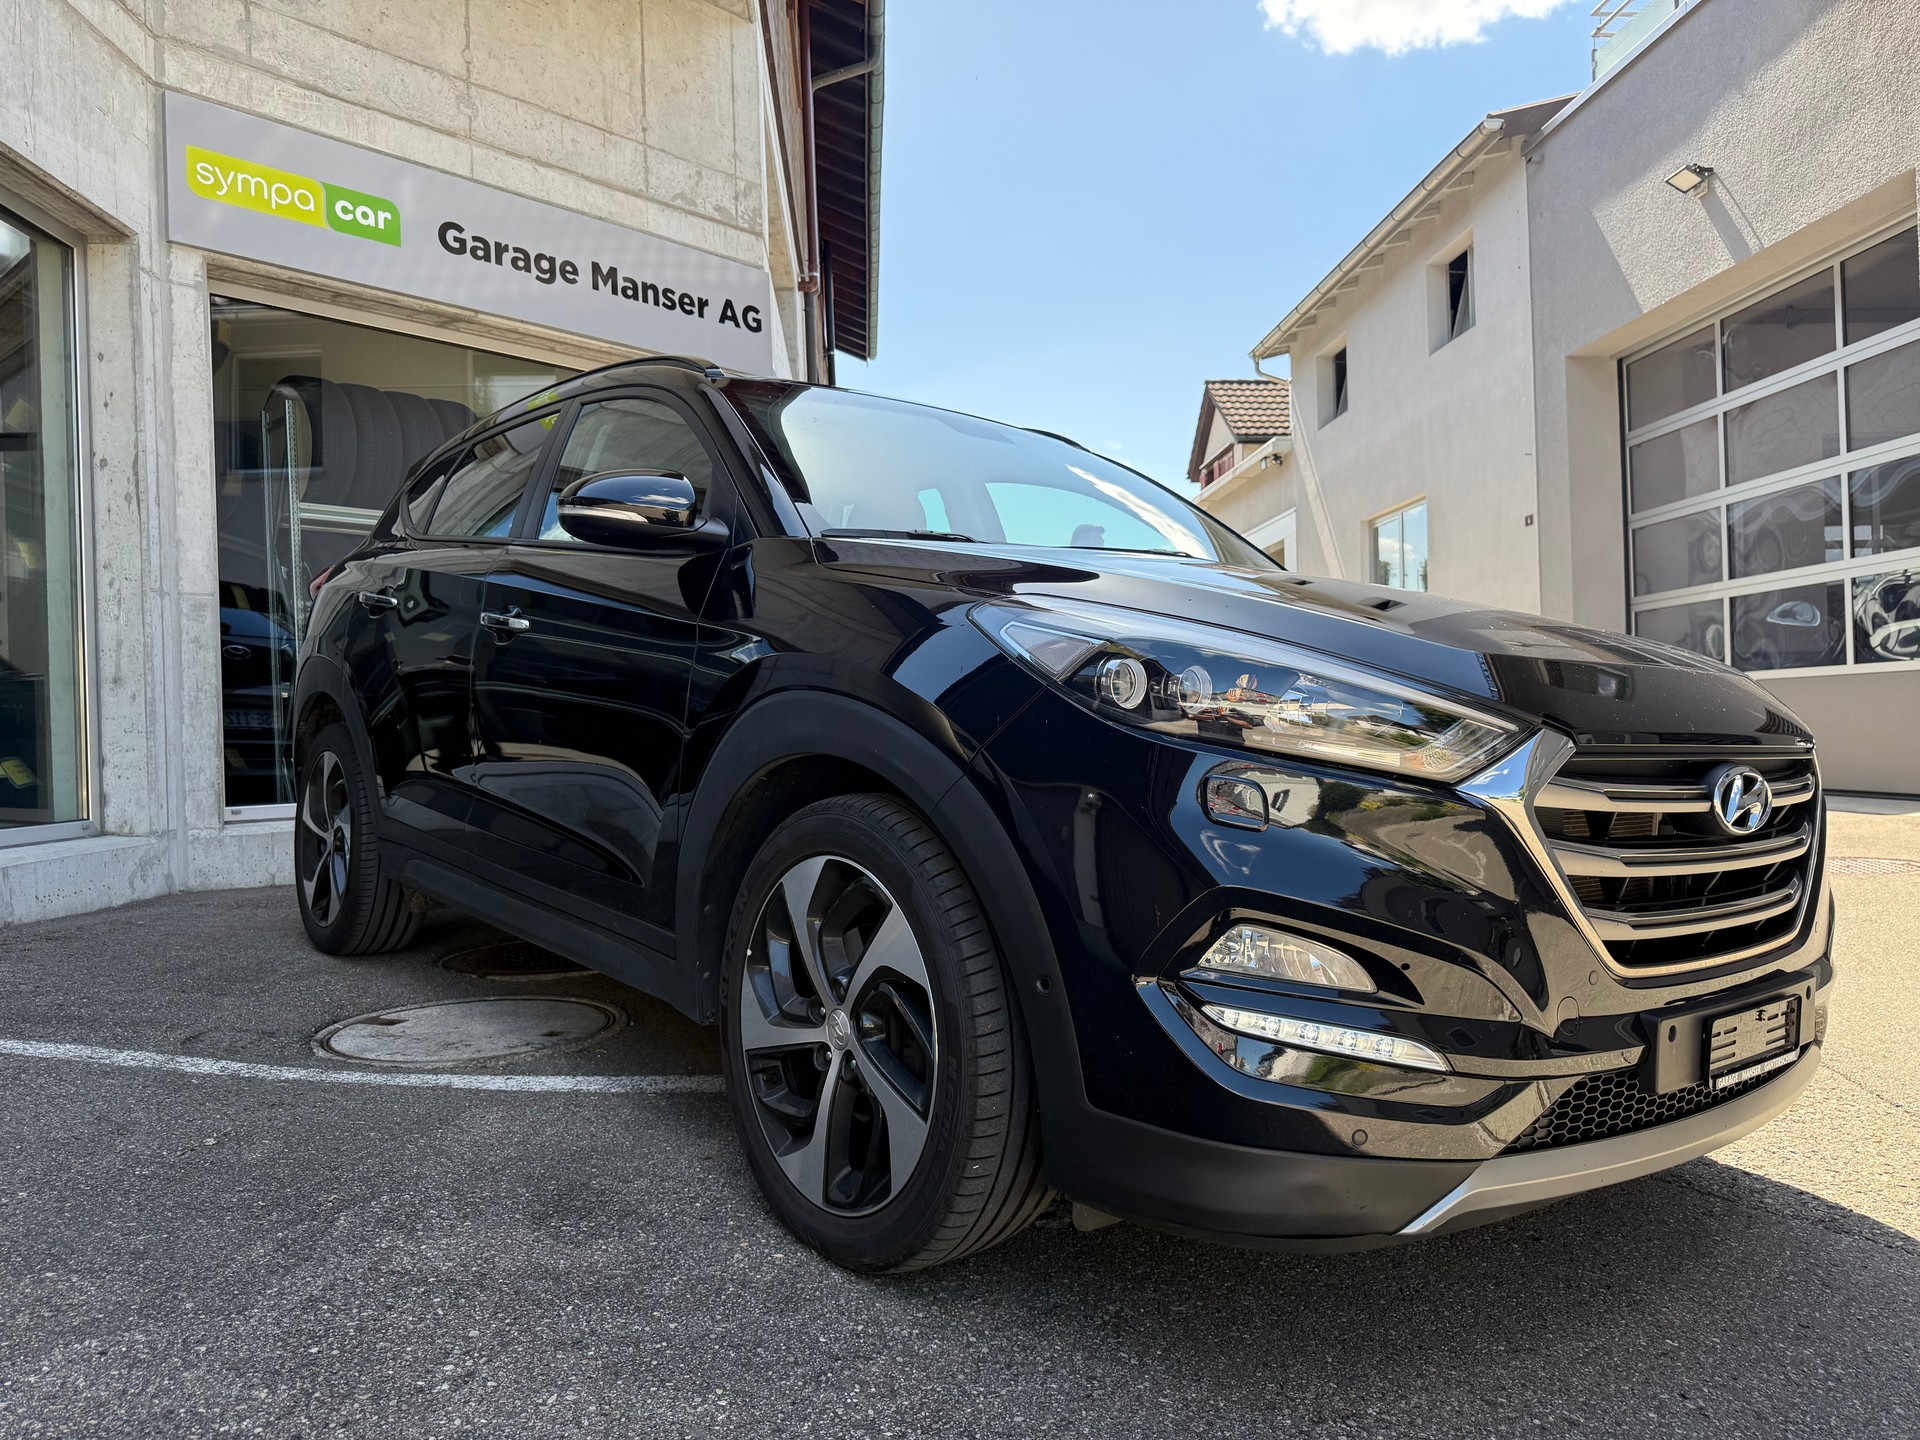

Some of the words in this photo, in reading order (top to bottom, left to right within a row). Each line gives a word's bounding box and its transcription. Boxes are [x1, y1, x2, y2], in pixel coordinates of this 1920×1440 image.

[196, 162, 315, 212] sympa
[335, 200, 392, 230] car
[437, 221, 579, 285] Garage
[591, 261, 709, 319] Manser
[719, 298, 763, 333] AG
[1718, 1073, 1739, 1088] GARAGE
